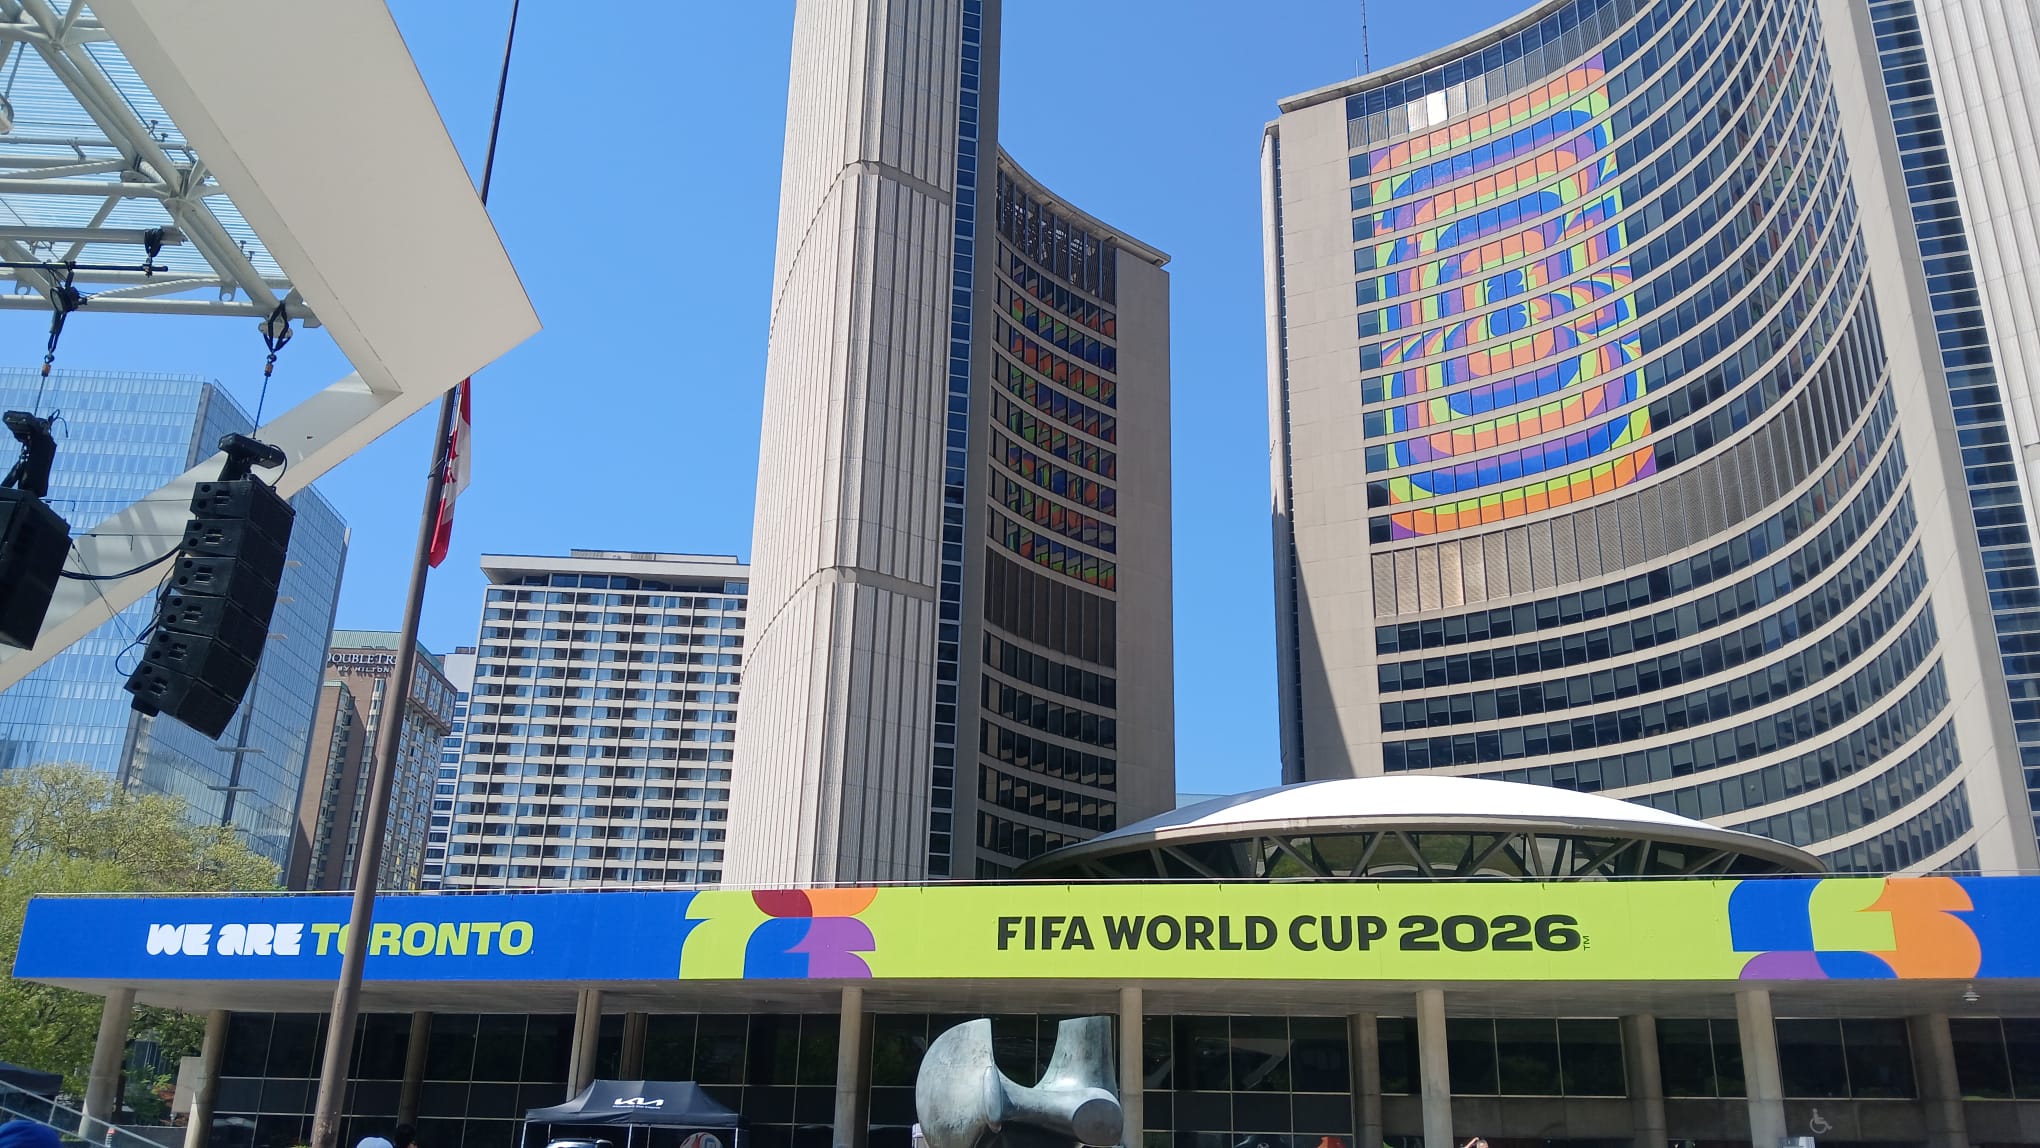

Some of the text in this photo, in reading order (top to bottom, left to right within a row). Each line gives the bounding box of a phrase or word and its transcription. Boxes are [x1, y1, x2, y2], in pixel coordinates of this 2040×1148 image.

[146, 923, 213, 956] WE
[997, 915, 1095, 951] FIFA
[1102, 914, 1278, 951] WORLD
[1288, 914, 1388, 952] CUP
[1398, 913, 1581, 952] 2026
